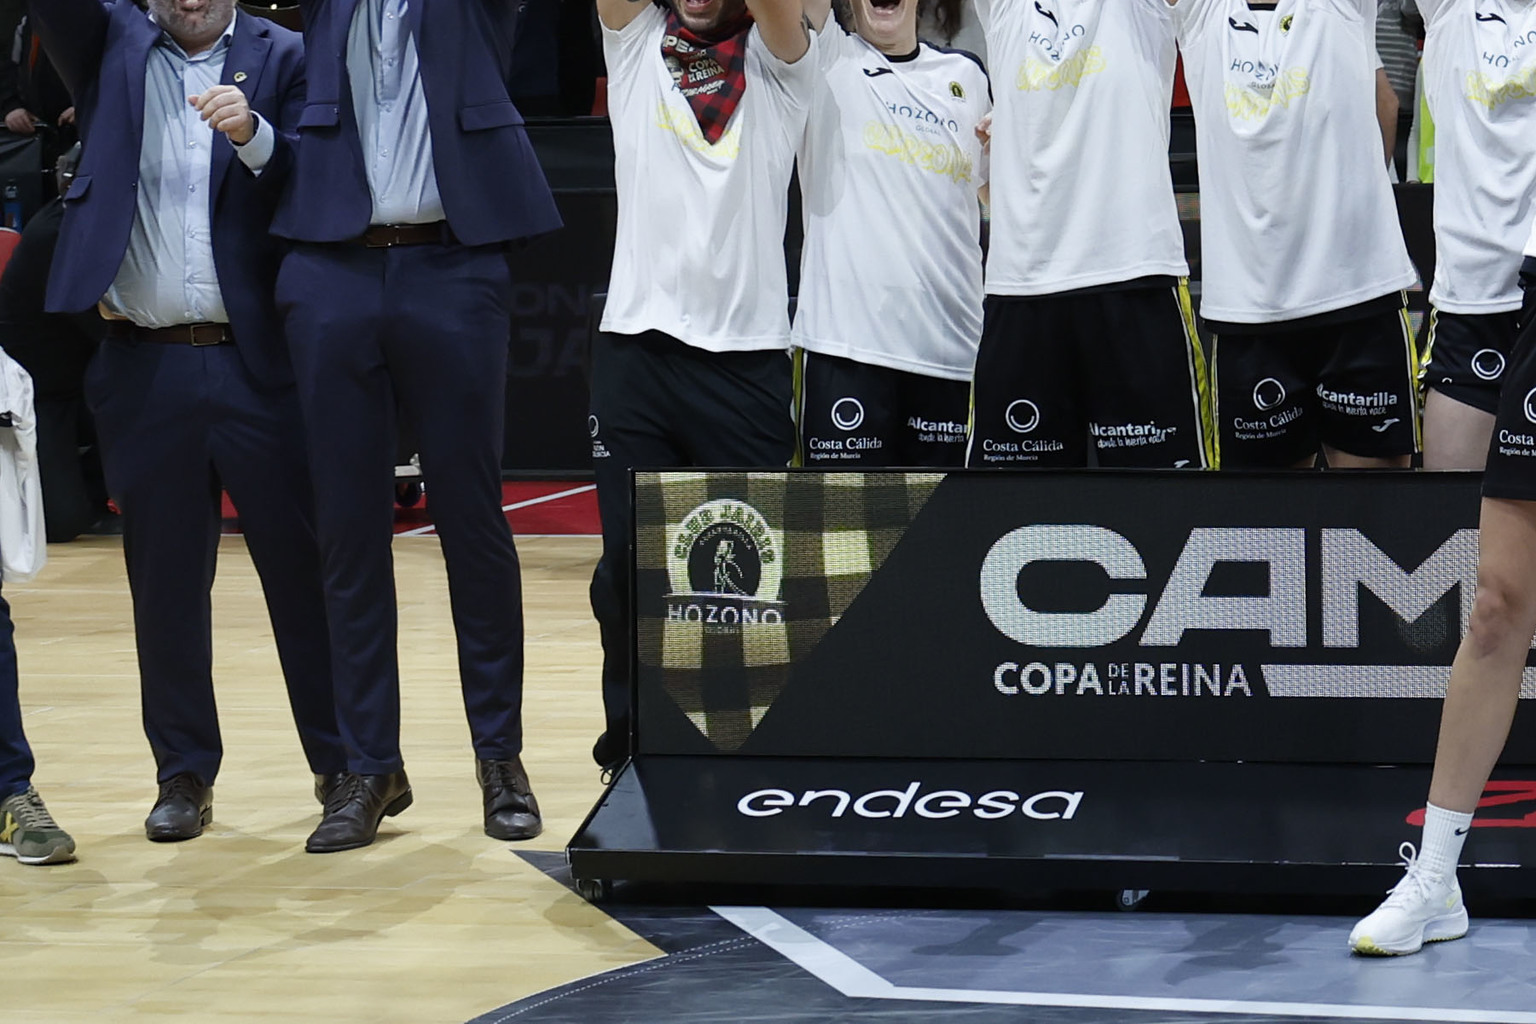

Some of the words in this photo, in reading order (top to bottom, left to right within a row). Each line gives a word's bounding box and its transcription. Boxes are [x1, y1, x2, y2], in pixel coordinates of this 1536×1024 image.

[688, 58, 719, 73] COPA
[696, 65, 726, 80] REINA
[1234, 417, 1268, 430] Costa
[809, 437, 843, 450] Costa
[846, 437, 882, 451] Cálida
[1499, 429, 1535, 446] Costa
[983, 439, 1019, 452] Costa
[1022, 439, 1064, 452] Cálida
[1500, 447, 1521, 457] Región
[668, 603, 782, 624] HOZONO
[994, 661, 1104, 697] COPA
[1108, 663, 1130, 678] DE
[1135, 663, 1253, 697] REINA
[1108, 680, 1131, 695] LA
[737, 781, 1084, 820] endesa
